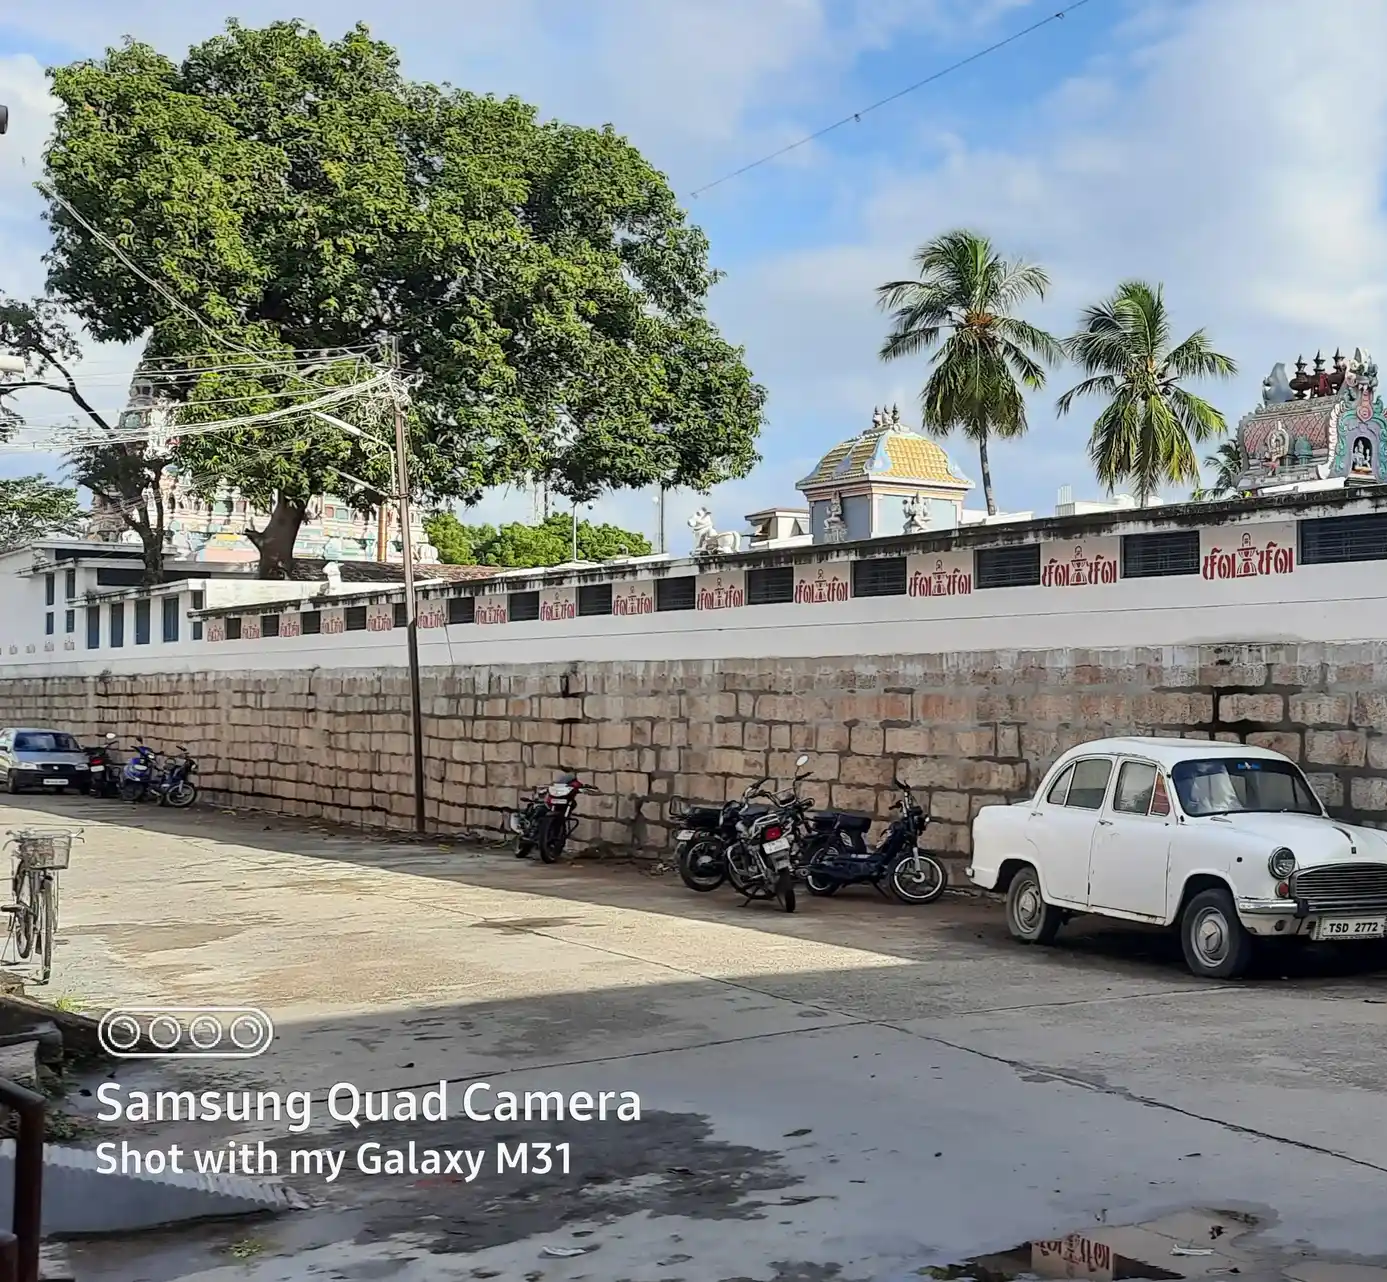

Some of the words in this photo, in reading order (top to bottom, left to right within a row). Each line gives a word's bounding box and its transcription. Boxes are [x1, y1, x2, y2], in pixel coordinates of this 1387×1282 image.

[1202, 547, 1236, 580] சிவ
[1256, 541, 1294, 576] சிவ
[1329, 923, 1349, 933] TSD
[1354, 922, 1378, 932] 2772
